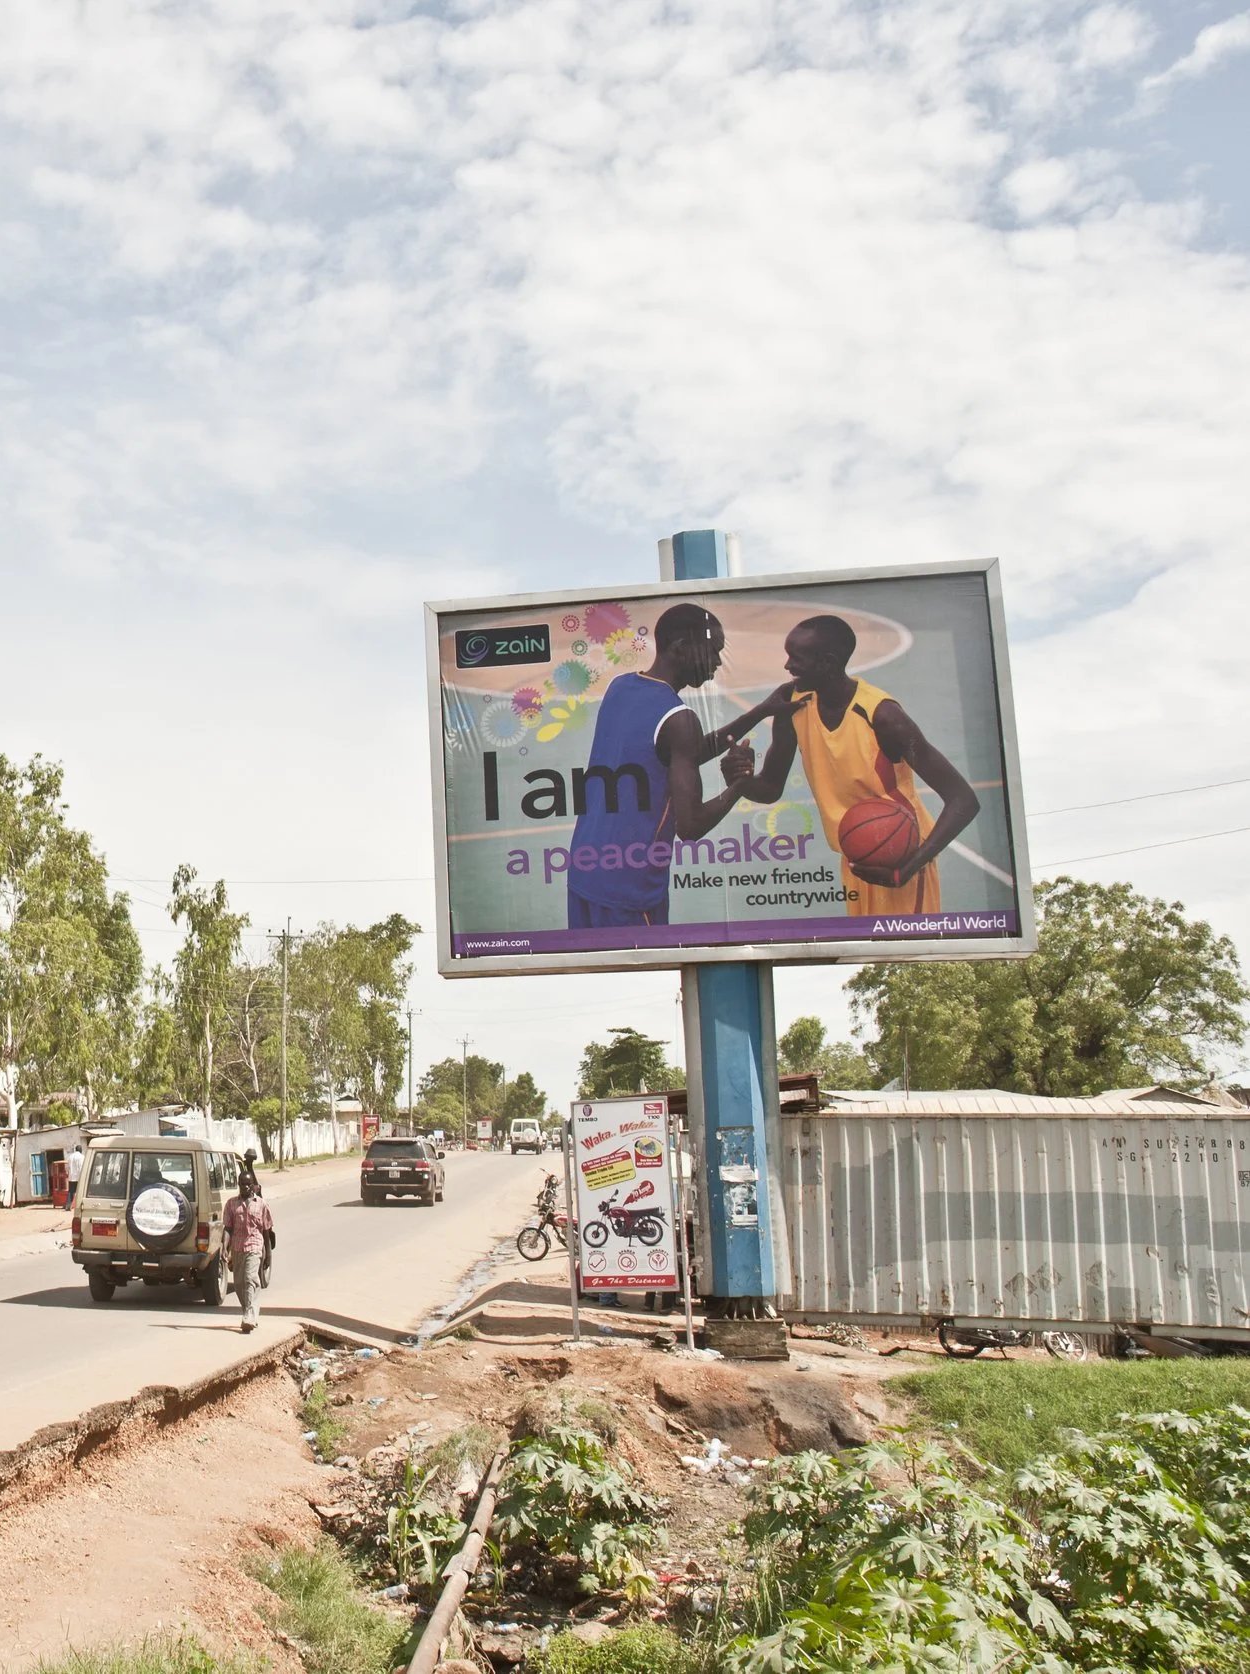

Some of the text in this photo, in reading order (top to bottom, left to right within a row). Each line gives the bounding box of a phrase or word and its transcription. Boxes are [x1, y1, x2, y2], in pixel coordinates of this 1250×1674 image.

[483, 751, 650, 821] I am
[506, 823, 814, 884] a peacemaker
[673, 866, 834, 889] Make new friends
[746, 886, 859, 908] countrywide
[873, 915, 1006, 932] A Wonderful World
[466, 939, 530, 948] www.zain.com
